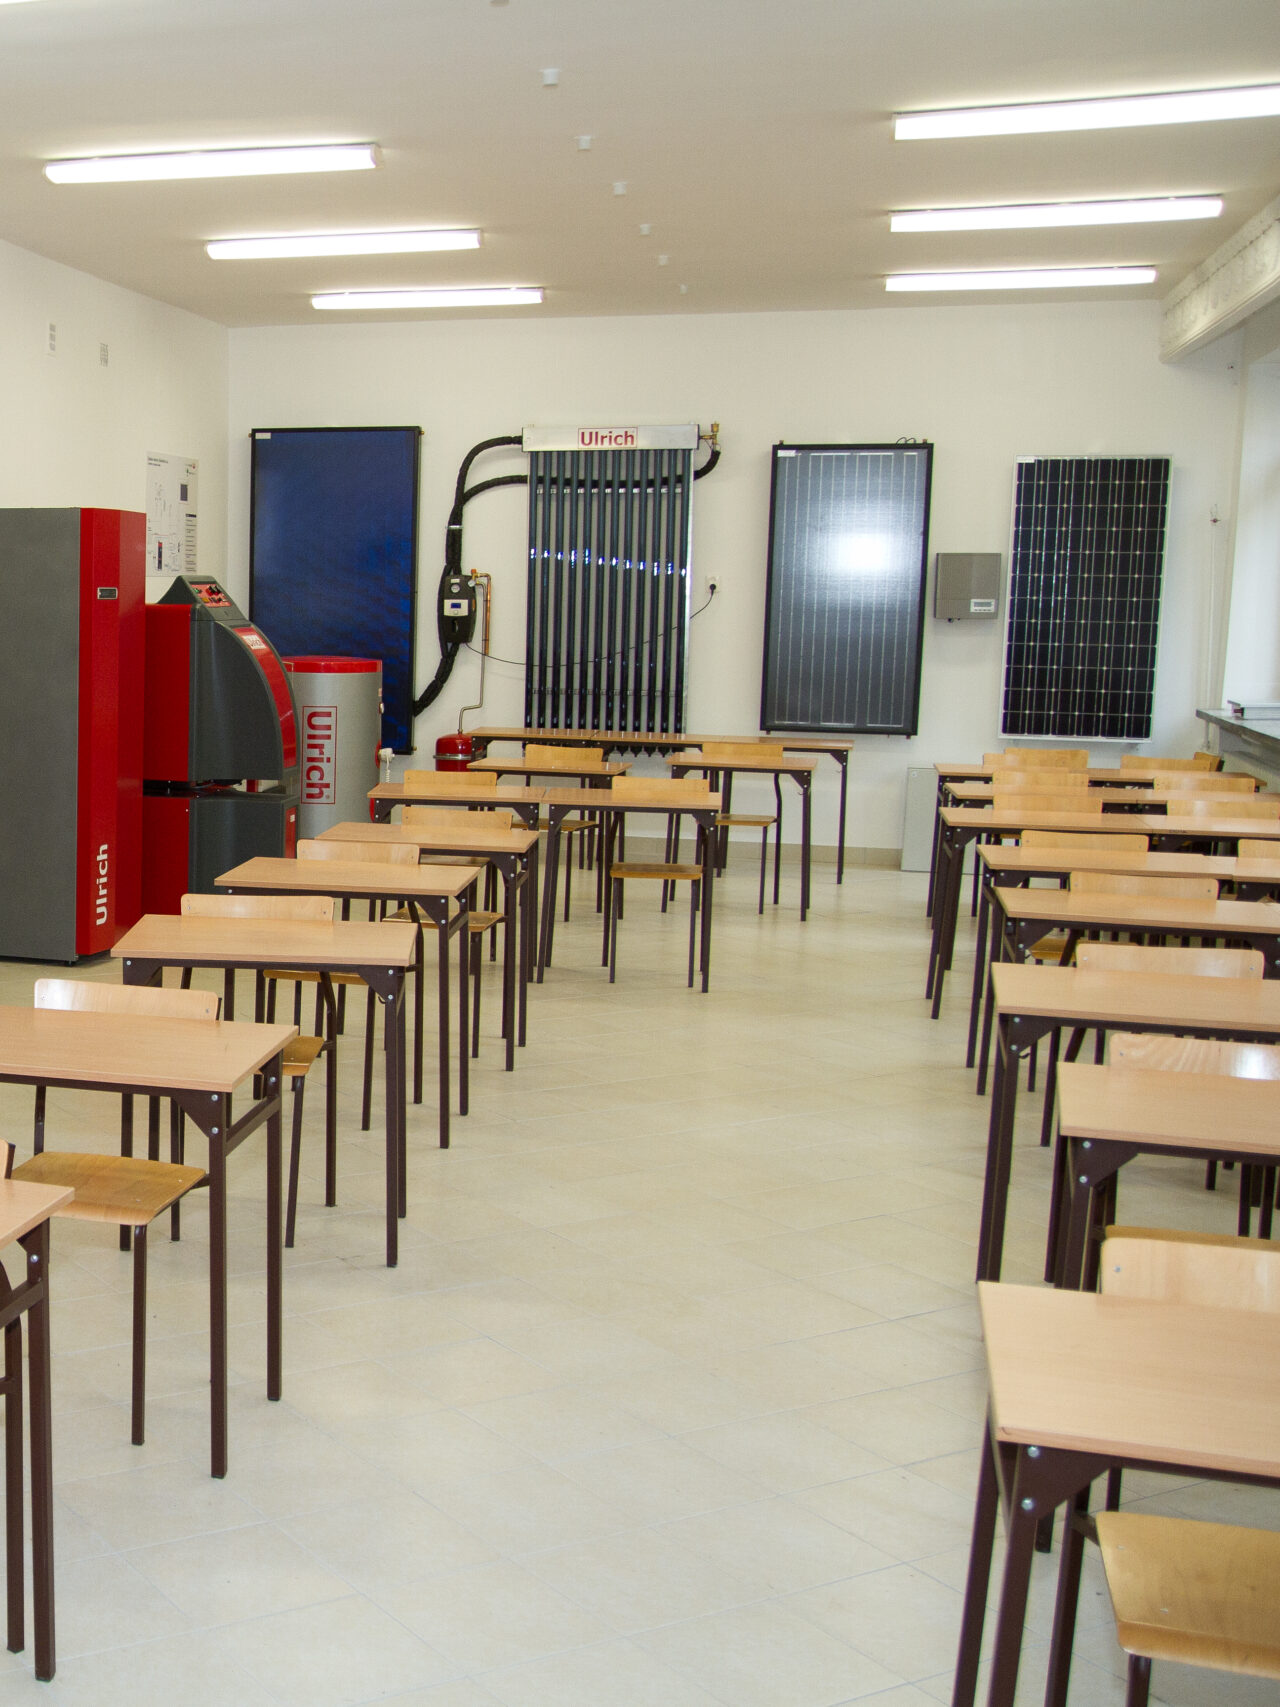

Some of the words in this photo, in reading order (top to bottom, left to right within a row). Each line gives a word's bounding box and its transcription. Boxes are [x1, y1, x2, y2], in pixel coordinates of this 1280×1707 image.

[581, 430, 635, 446] Ulrich
[305, 711, 332, 799] Ulrich
[95, 844, 109, 926] Ulrich
